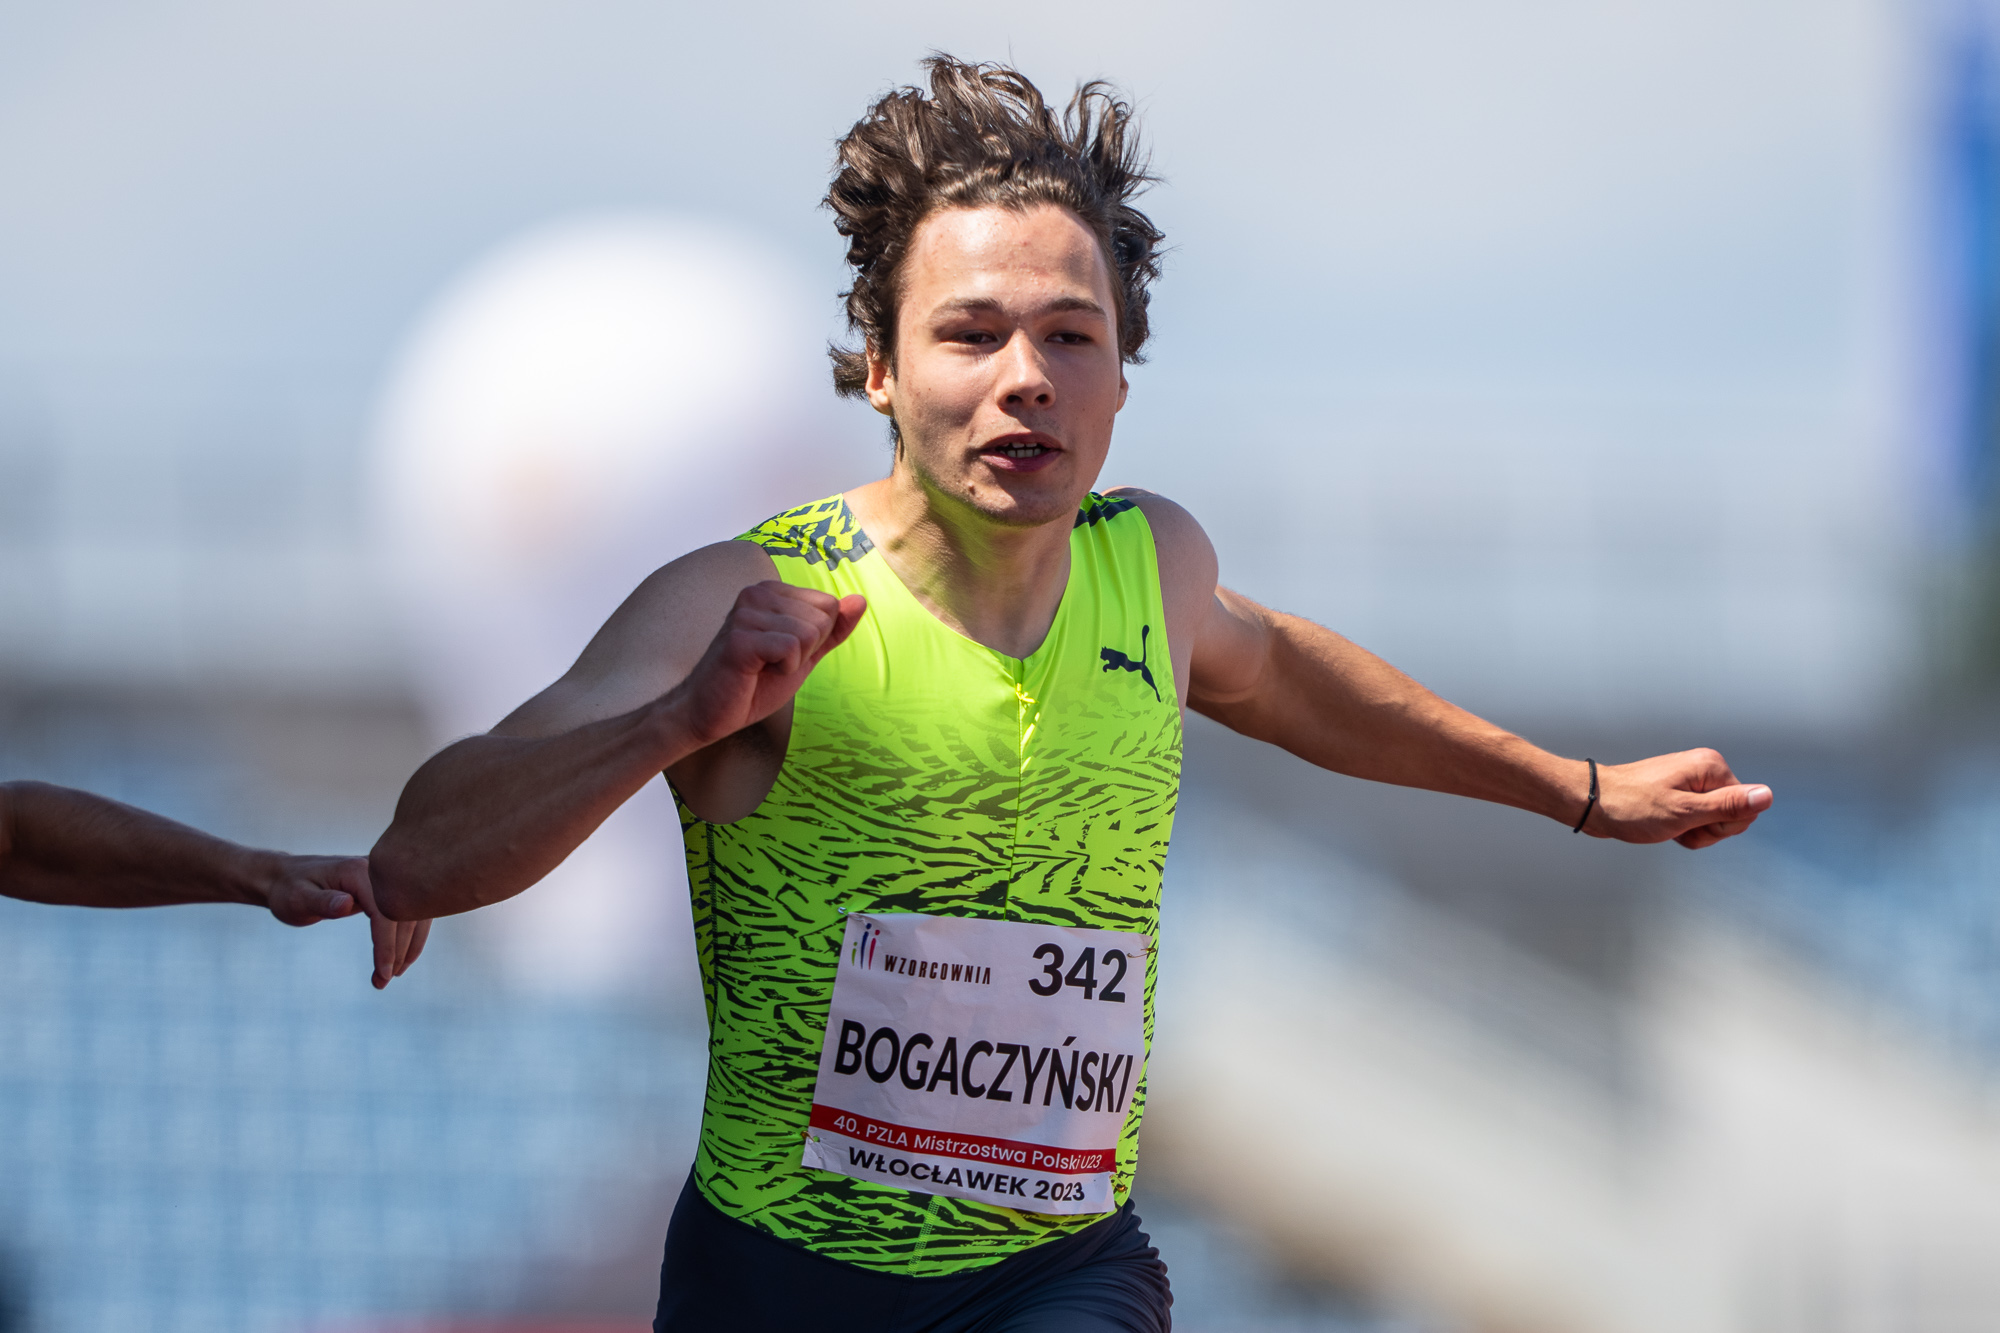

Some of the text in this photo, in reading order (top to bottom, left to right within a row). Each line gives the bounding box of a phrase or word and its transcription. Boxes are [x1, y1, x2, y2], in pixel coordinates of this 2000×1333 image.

[884, 954, 991, 985] WZORCOWNIA
[1028, 943, 1128, 1003] 342
[834, 1018, 1134, 1114] BOGACZYŃSKI
[833, 1115, 1103, 1170] 40. PZLA Mistrzostwa Polski U23
[848, 1146, 1085, 1202] WŁOCŁAWEK 2023
